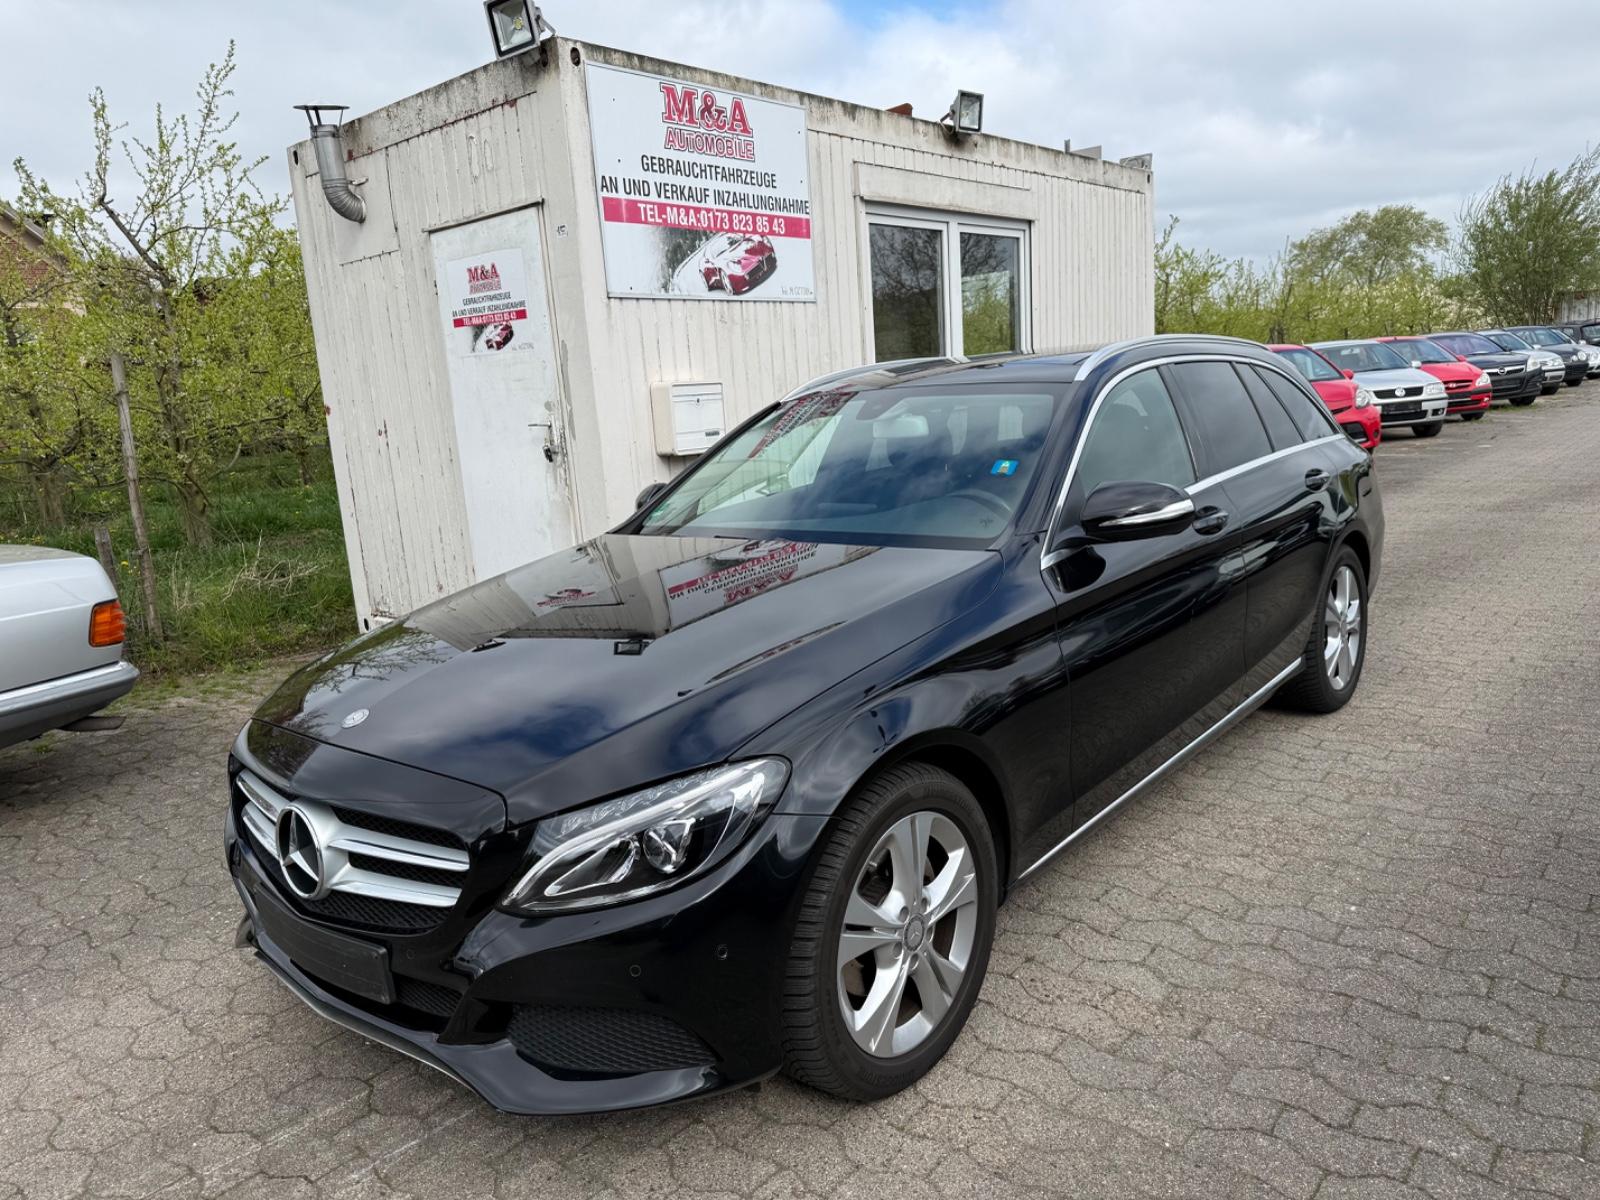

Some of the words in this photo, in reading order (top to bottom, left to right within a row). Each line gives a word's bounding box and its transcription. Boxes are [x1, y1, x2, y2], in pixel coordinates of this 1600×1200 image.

[660, 82, 753, 138] M&A
[664, 127, 755, 162] AUTOMOBILE
[641, 154, 777, 189] GEBRAUCHTFAHRZEUGE
[600, 175, 618, 194] AN
[623, 178, 650, 197] UND
[654, 181, 710, 203] VERKAUF
[713, 189, 810, 215] INZAHLUNGNAHME
[732, 213, 753, 232] 823
[756, 216, 770, 233] 85
[772, 218, 785, 234] 43
[467, 262, 500, 283] M&A
